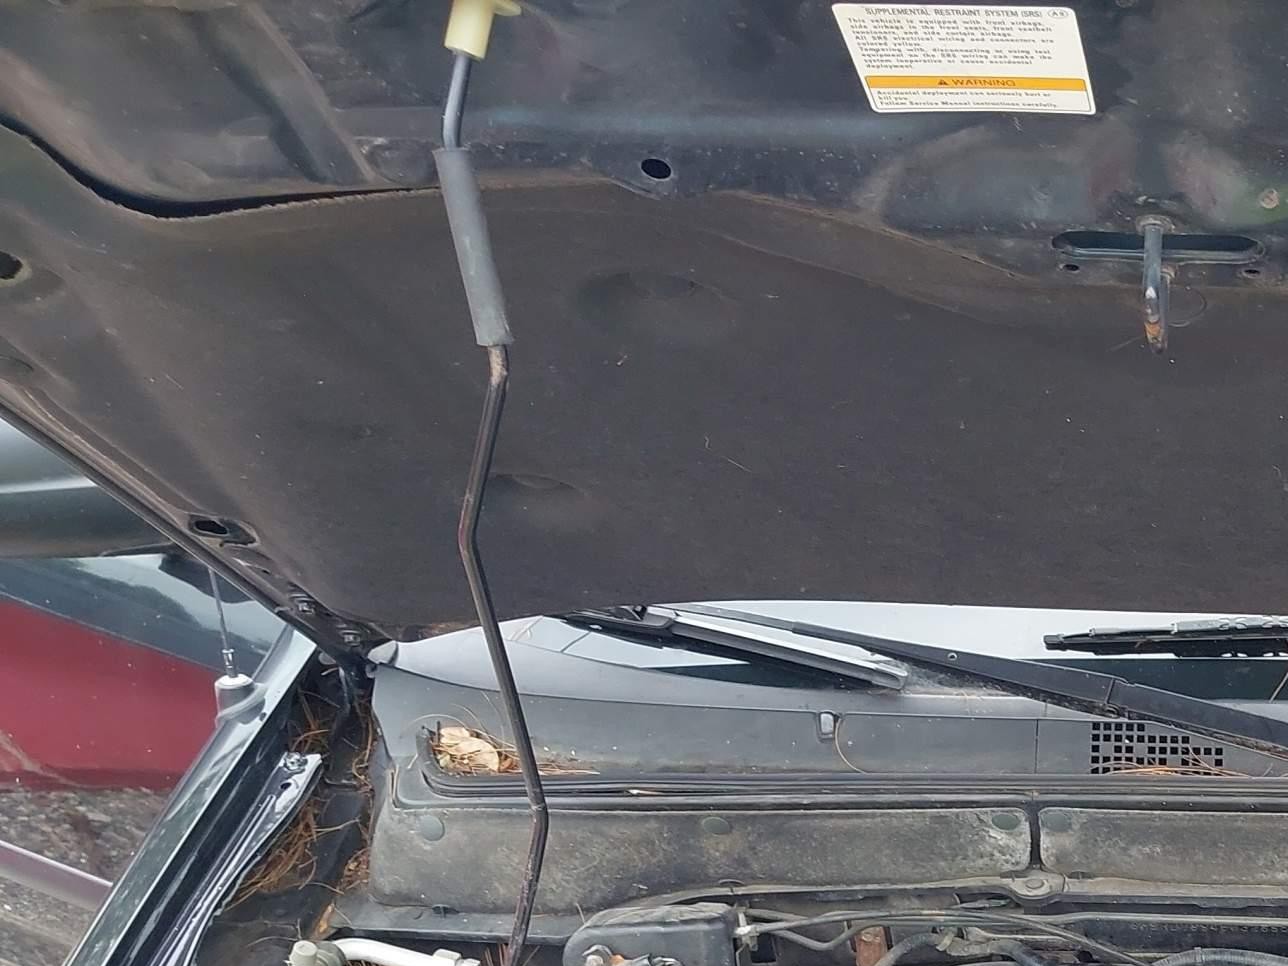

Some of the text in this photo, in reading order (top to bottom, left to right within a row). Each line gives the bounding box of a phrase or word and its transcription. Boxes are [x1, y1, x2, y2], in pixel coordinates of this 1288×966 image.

[865, 8, 931, 16] SUPPLEMENTAL
[934, 8, 981, 17] RESTRAINT
[985, 9, 1019, 17] SYSTEM
[952, 79, 1017, 87] WARNING
